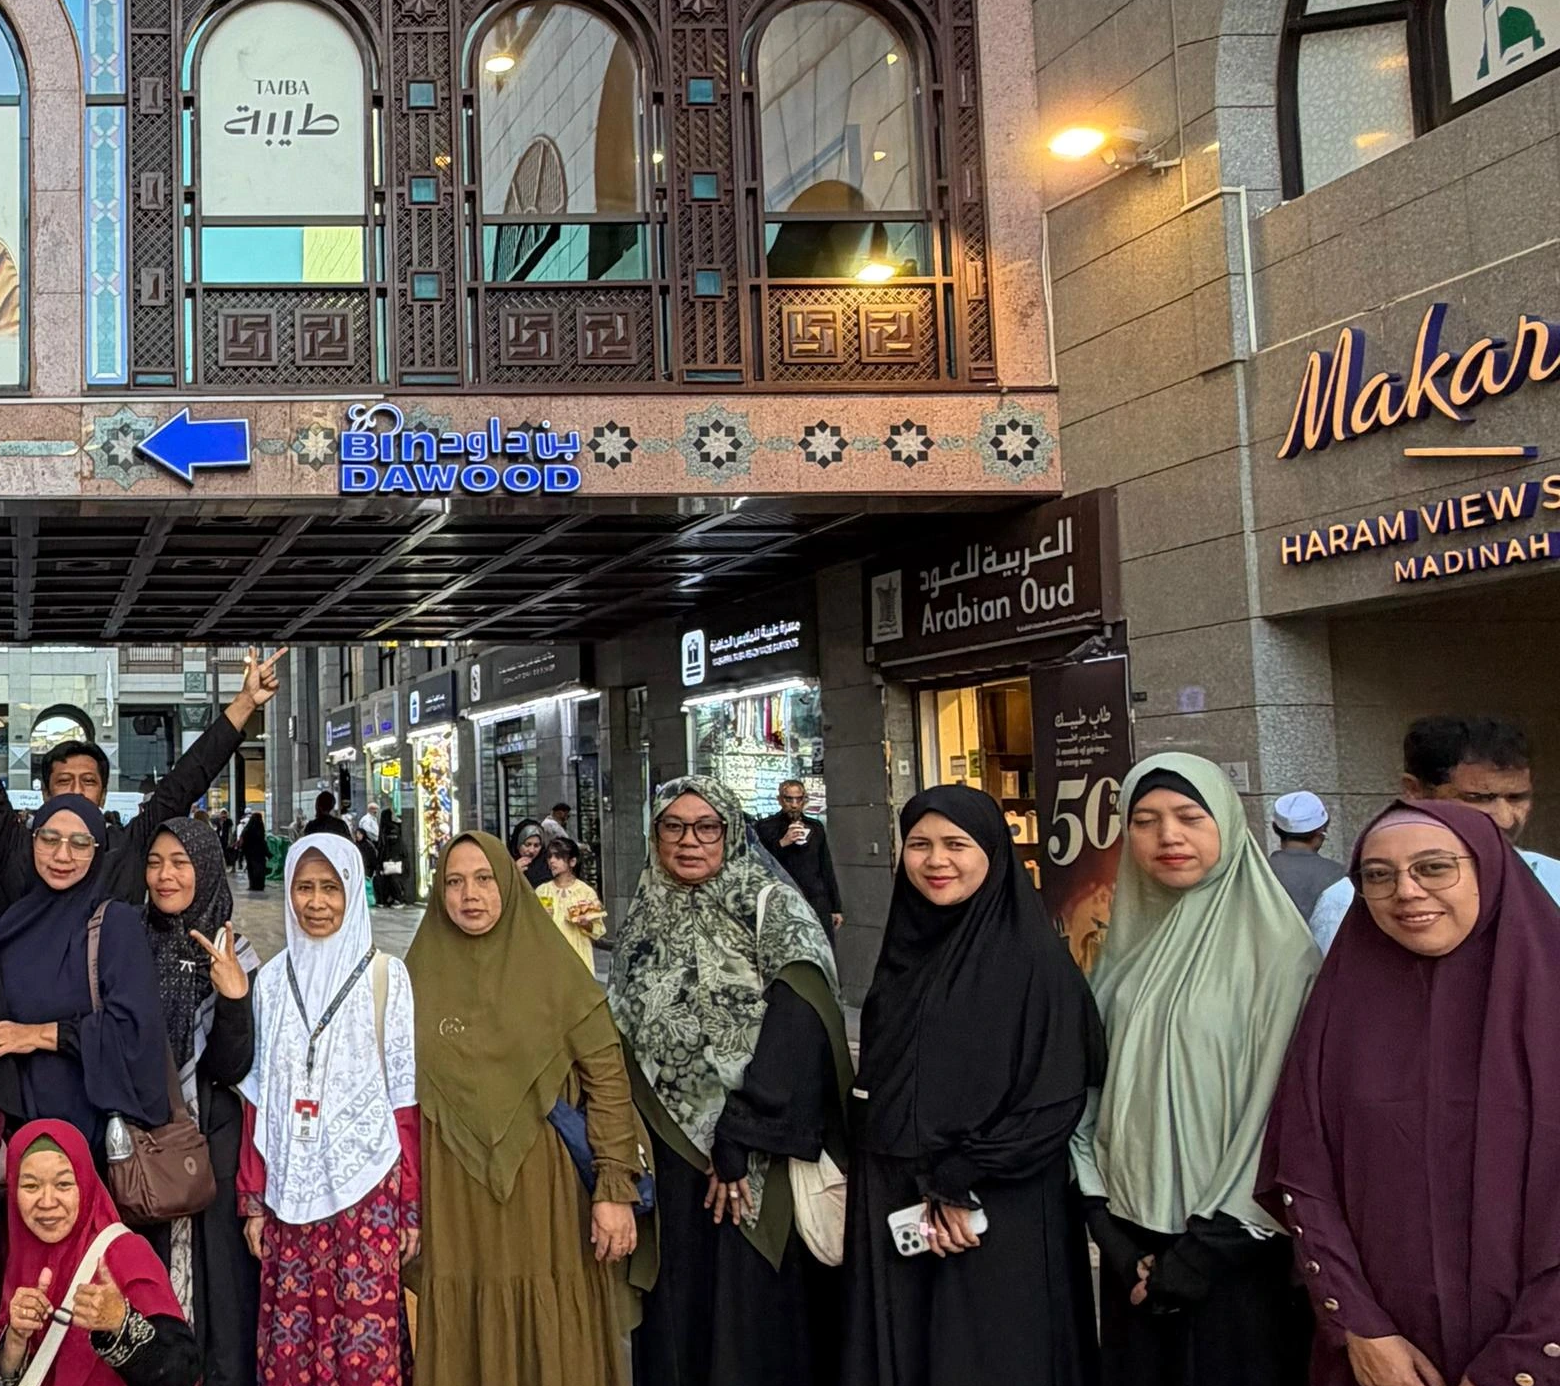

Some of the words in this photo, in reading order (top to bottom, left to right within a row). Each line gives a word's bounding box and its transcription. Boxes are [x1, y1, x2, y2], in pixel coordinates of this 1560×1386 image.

[253, 79, 310, 95] TAIBA
[223, 103, 340, 147] طيبة
[1276, 302, 1560, 459] Makar
[440, 416, 529, 462] داود
[536, 419, 580, 461] بن
[342, 464, 582, 493] DAWOOD
[982, 516, 1073, 578] العربية
[1281, 510, 1407, 565] HARAM
[1420, 482, 1527, 534] VIEW
[919, 543, 980, 599] للعود
[1394, 532, 1551, 583] MADINAH
[921, 592, 1011, 636] Arabian
[1020, 565, 1075, 614] Oud
